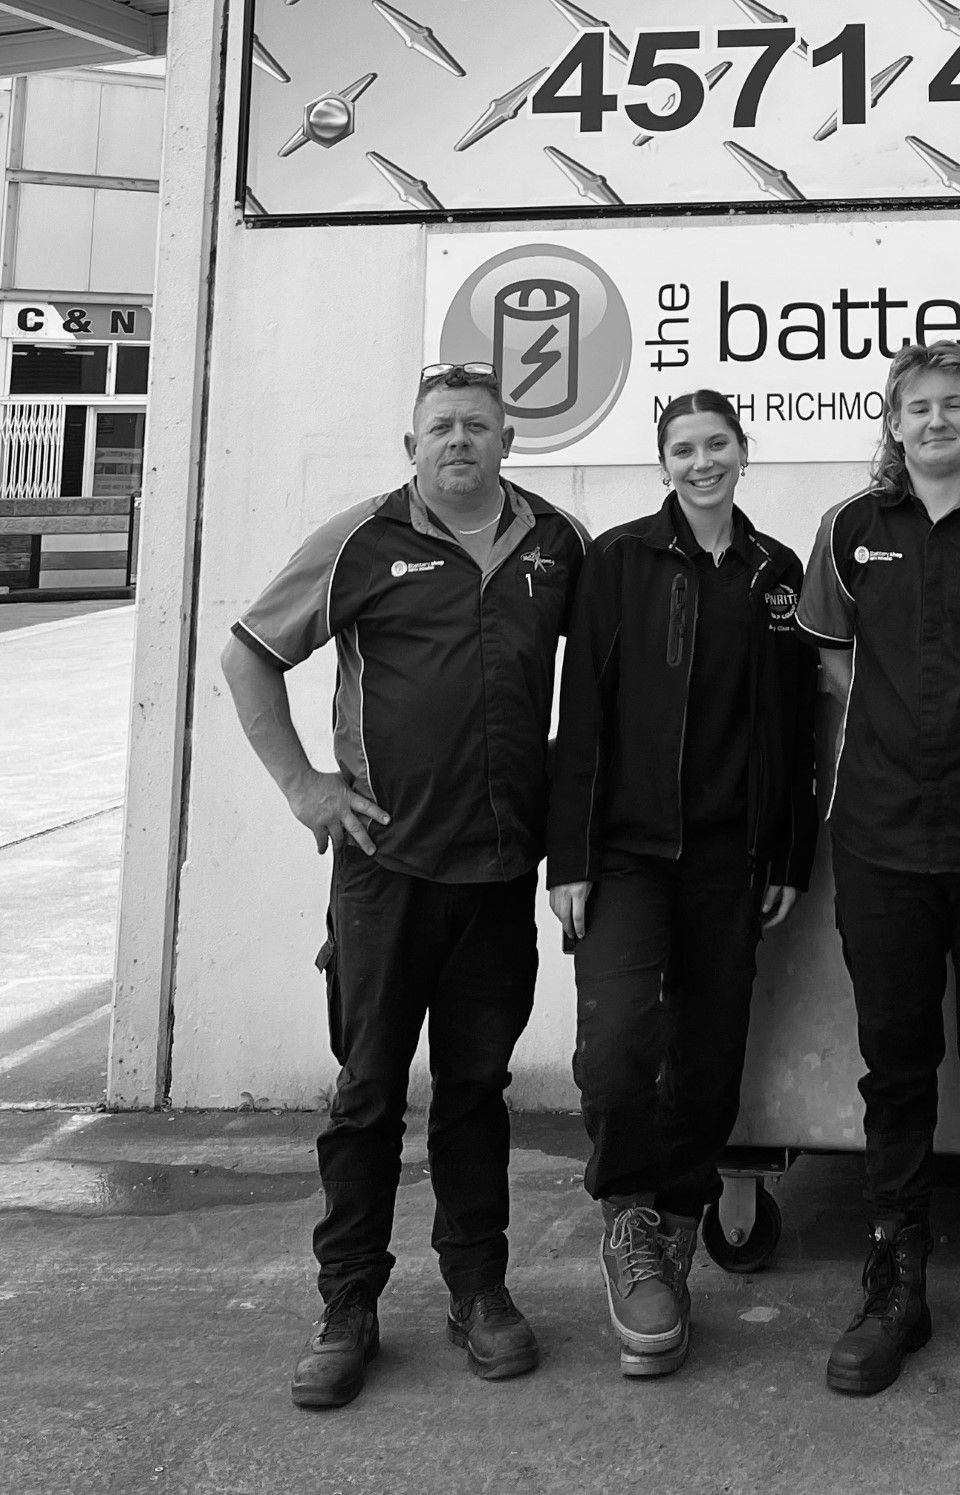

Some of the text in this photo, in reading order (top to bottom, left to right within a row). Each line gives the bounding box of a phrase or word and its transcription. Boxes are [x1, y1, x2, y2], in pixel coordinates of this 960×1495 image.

[531, 22, 867, 133] 4571
[17, 307, 135, 333] C & N
[645, 282, 690, 372] the
[766, 391, 884, 422] RICHMO
